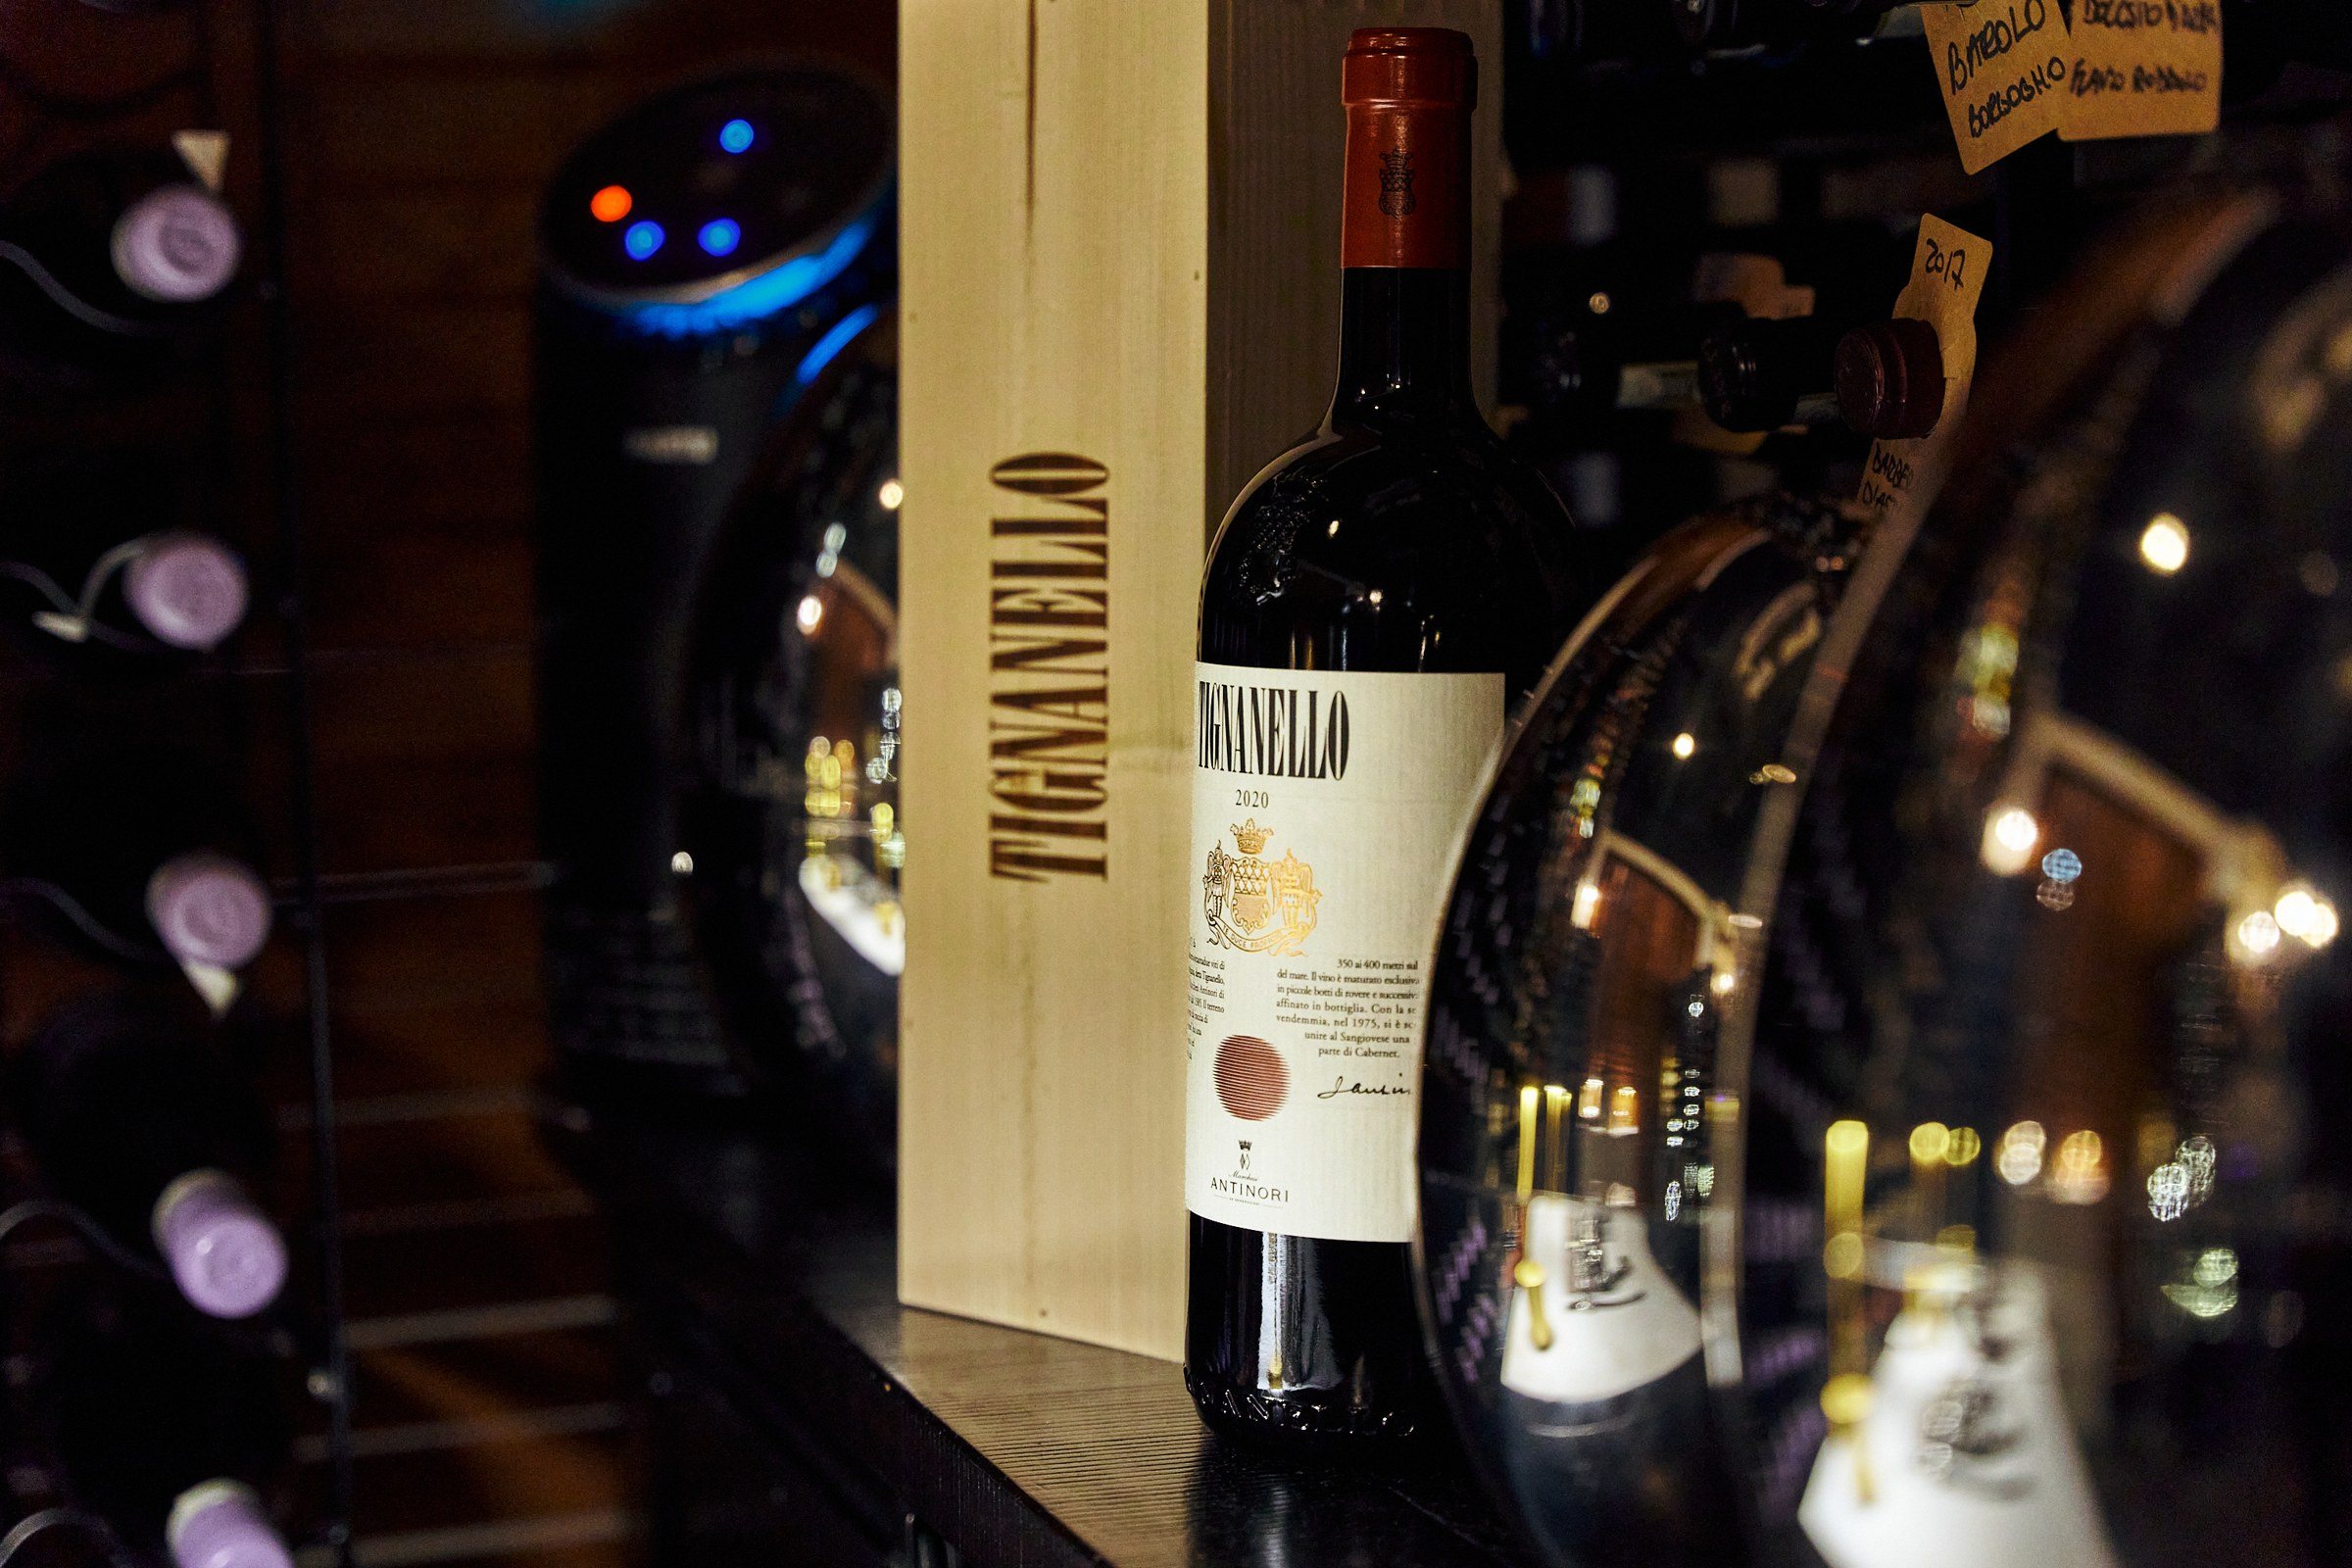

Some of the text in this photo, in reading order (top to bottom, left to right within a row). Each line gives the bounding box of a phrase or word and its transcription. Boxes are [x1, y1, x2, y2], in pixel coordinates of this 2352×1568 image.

[1925, 238, 1966, 291] 2017
[988, 452, 1109, 883] TIGNANELLO
[1198, 680, 1349, 781] TIGNANELLO
[1236, 789, 1269, 808] 2020
[1337, 958, 1353, 968] 350
[1354, 959, 1363, 968] ai
[1363, 959, 1381, 969] 400
[1382, 960, 1404, 970] metri
[1277, 968, 1288, 979] del
[1289, 972, 1309, 981] mare.
[1311, 971, 1316, 981] Il
[1318, 972, 1335, 982] vino
[1344, 975, 1383, 984] maturato
[1277, 984, 1285, 993] in
[1286, 985, 1312, 996] piccole
[1314, 986, 1333, 997] botti
[1334, 987, 1343, 997] di
[1276, 999, 1309, 1010] affinato
[1312, 1001, 1321, 1010] in
[1324, 1001, 1368, 1014] bottiglia.
[1371, 1004, 1393, 1014] Con
[1396, 1004, 1404, 1013] la
[1276, 1014, 1330, 1027] vendemmia,
[1334, 1017, 1348, 1027] nel
[1352, 1017, 1380, 1029] 1975,
[1384, 1019, 1392, 1028] si
[1304, 1031, 1328, 1040] unire
[1330, 1032, 1338, 1041] al
[1341, 1032, 1390, 1045] Sangiovese
[1318, 1046, 1400, 1058] parte di Cabernet.
[1210, 1177, 1289, 1202] ANTINORI
